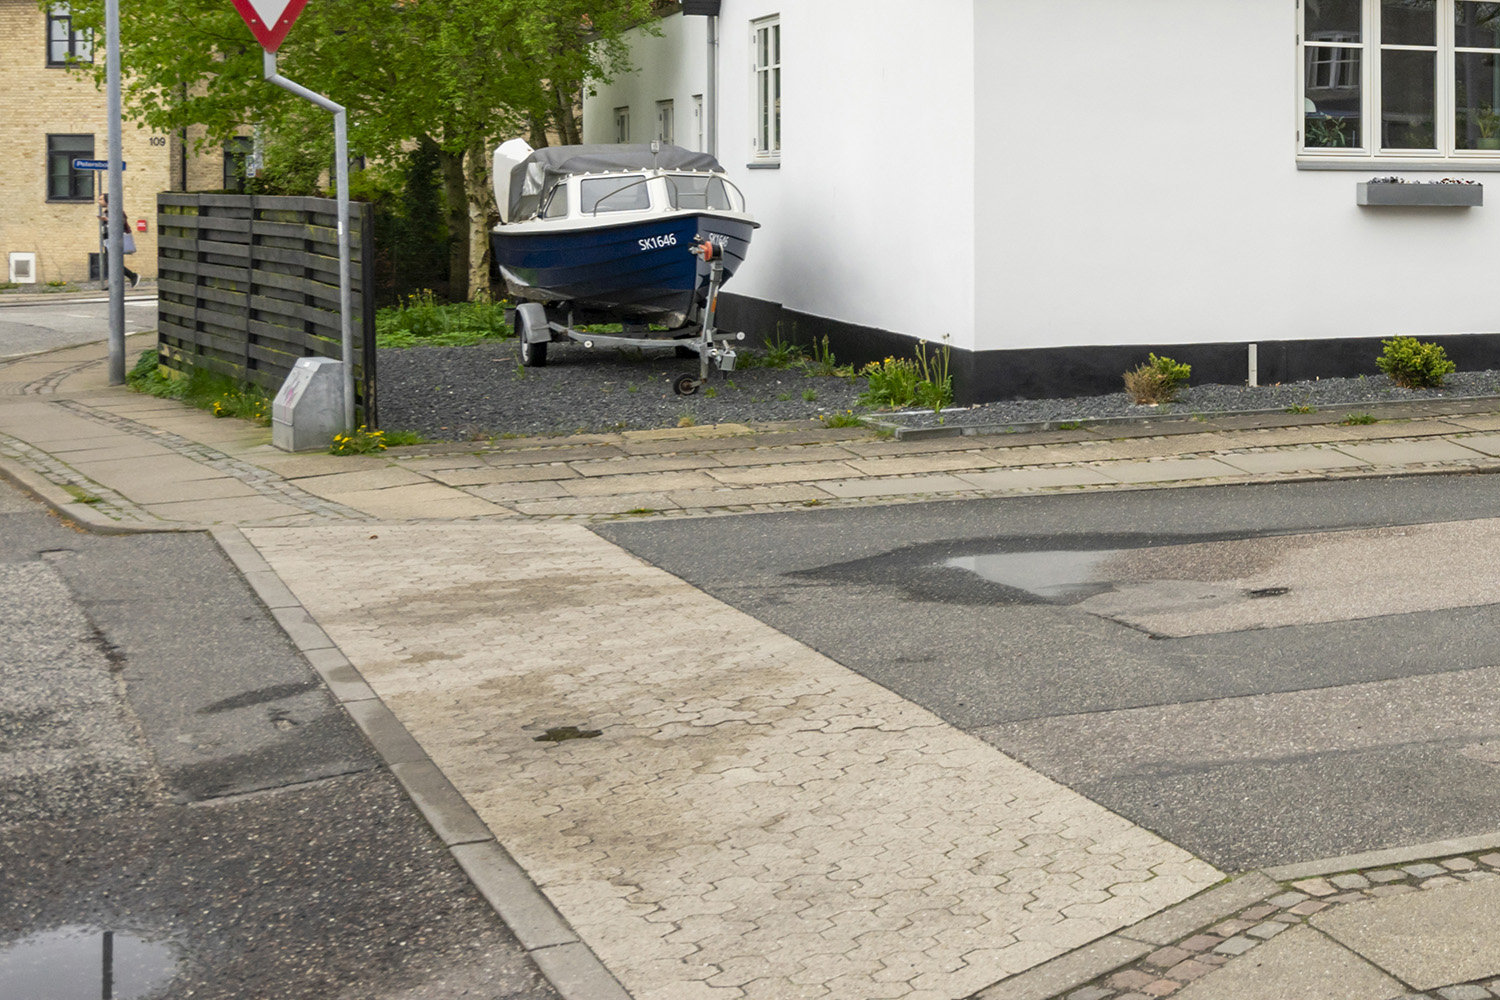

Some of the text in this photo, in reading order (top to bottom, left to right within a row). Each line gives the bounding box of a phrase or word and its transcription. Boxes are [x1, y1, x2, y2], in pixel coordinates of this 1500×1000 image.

[149, 136, 166, 146] 109
[76, 160, 108, 168] Petersbo
[638, 233, 677, 251] SK1646
